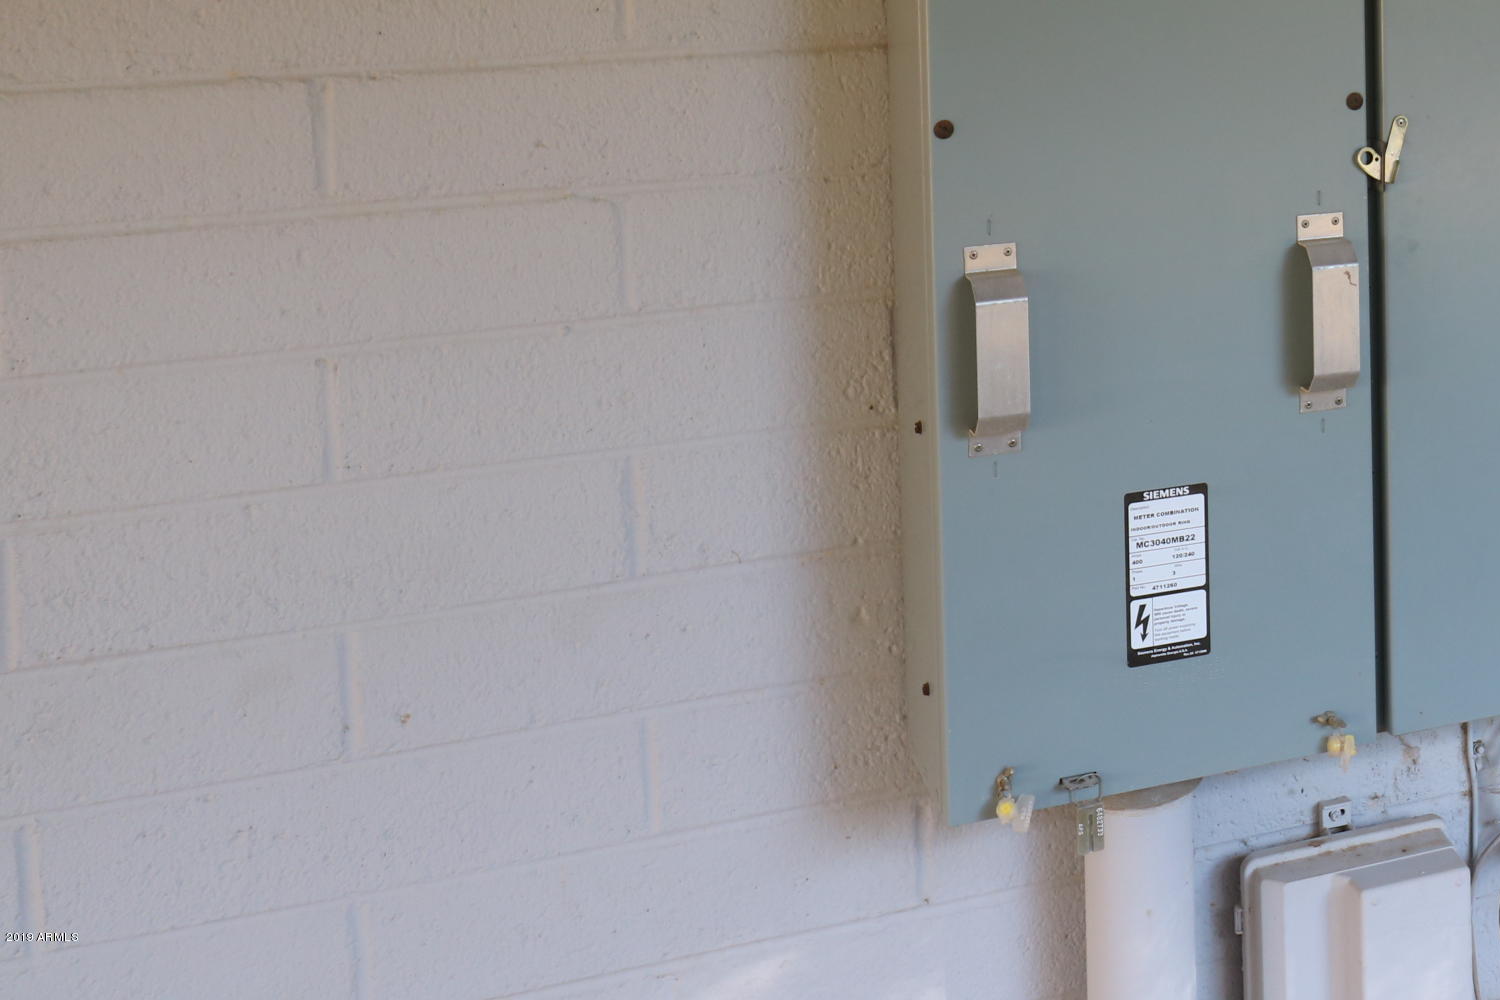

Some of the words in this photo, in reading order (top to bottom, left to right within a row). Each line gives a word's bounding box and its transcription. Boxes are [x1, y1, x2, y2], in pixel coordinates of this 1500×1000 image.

[1142, 486, 1190, 500] SIEMENS
[1156, 506, 1200, 518] COMBINATION
[1136, 534, 1196, 549] MC3040MB22
